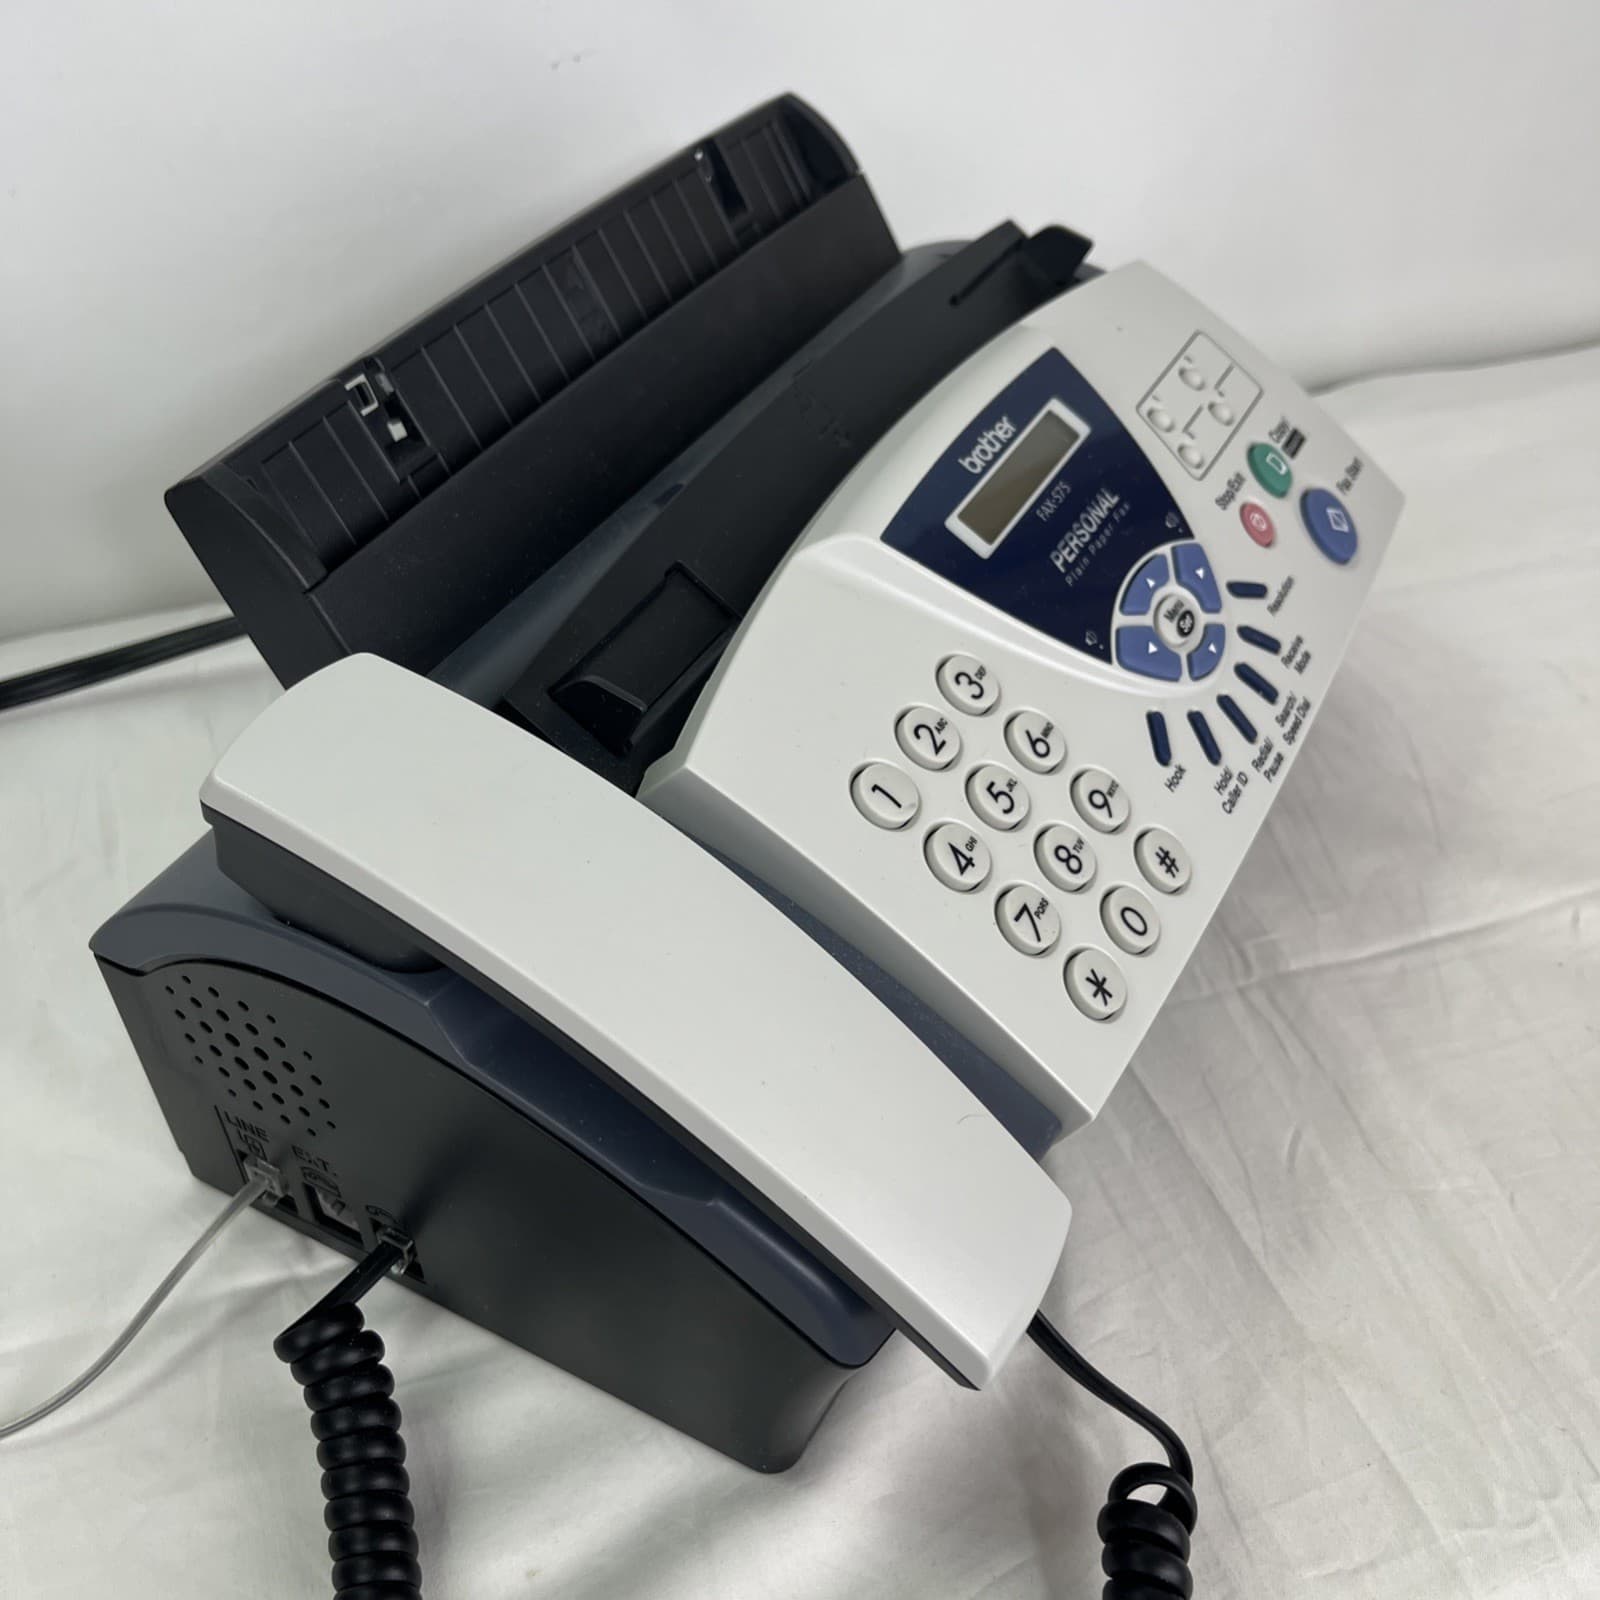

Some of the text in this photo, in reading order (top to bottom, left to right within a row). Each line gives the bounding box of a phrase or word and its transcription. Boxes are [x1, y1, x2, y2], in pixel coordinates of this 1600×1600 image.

[958, 415, 1017, 475] brother
[1036, 481, 1072, 522] FAX-575
[1050, 487, 1120, 573] PERSONAL
[1065, 555, 1090, 587] Plain
[1088, 522, 1115, 557] Paper
[1163, 600, 1184, 623] Menu
[954, 671, 985, 700] 3
[934, 717, 949, 735] ABC
[1283, 696, 1311, 746] Speed Dial
[913, 723, 947, 755] 2
[1025, 728, 1051, 758] 6
[1164, 765, 1187, 792] Hook
[1263, 752, 1284, 783] Pause
[871, 783, 902, 809] 1
[986, 781, 1015, 814] 5
[1088, 789, 1113, 819] 9
[1221, 771, 1249, 815] Caller ID
[948, 842, 975, 875] 4
[964, 836, 978, 853] GHI
[1053, 844, 1082, 875] 8
[1073, 838, 1085, 854] TUV
[1155, 846, 1180, 878] #
[1014, 903, 1041, 942] 7
[224, 1111, 270, 1143] LINE
